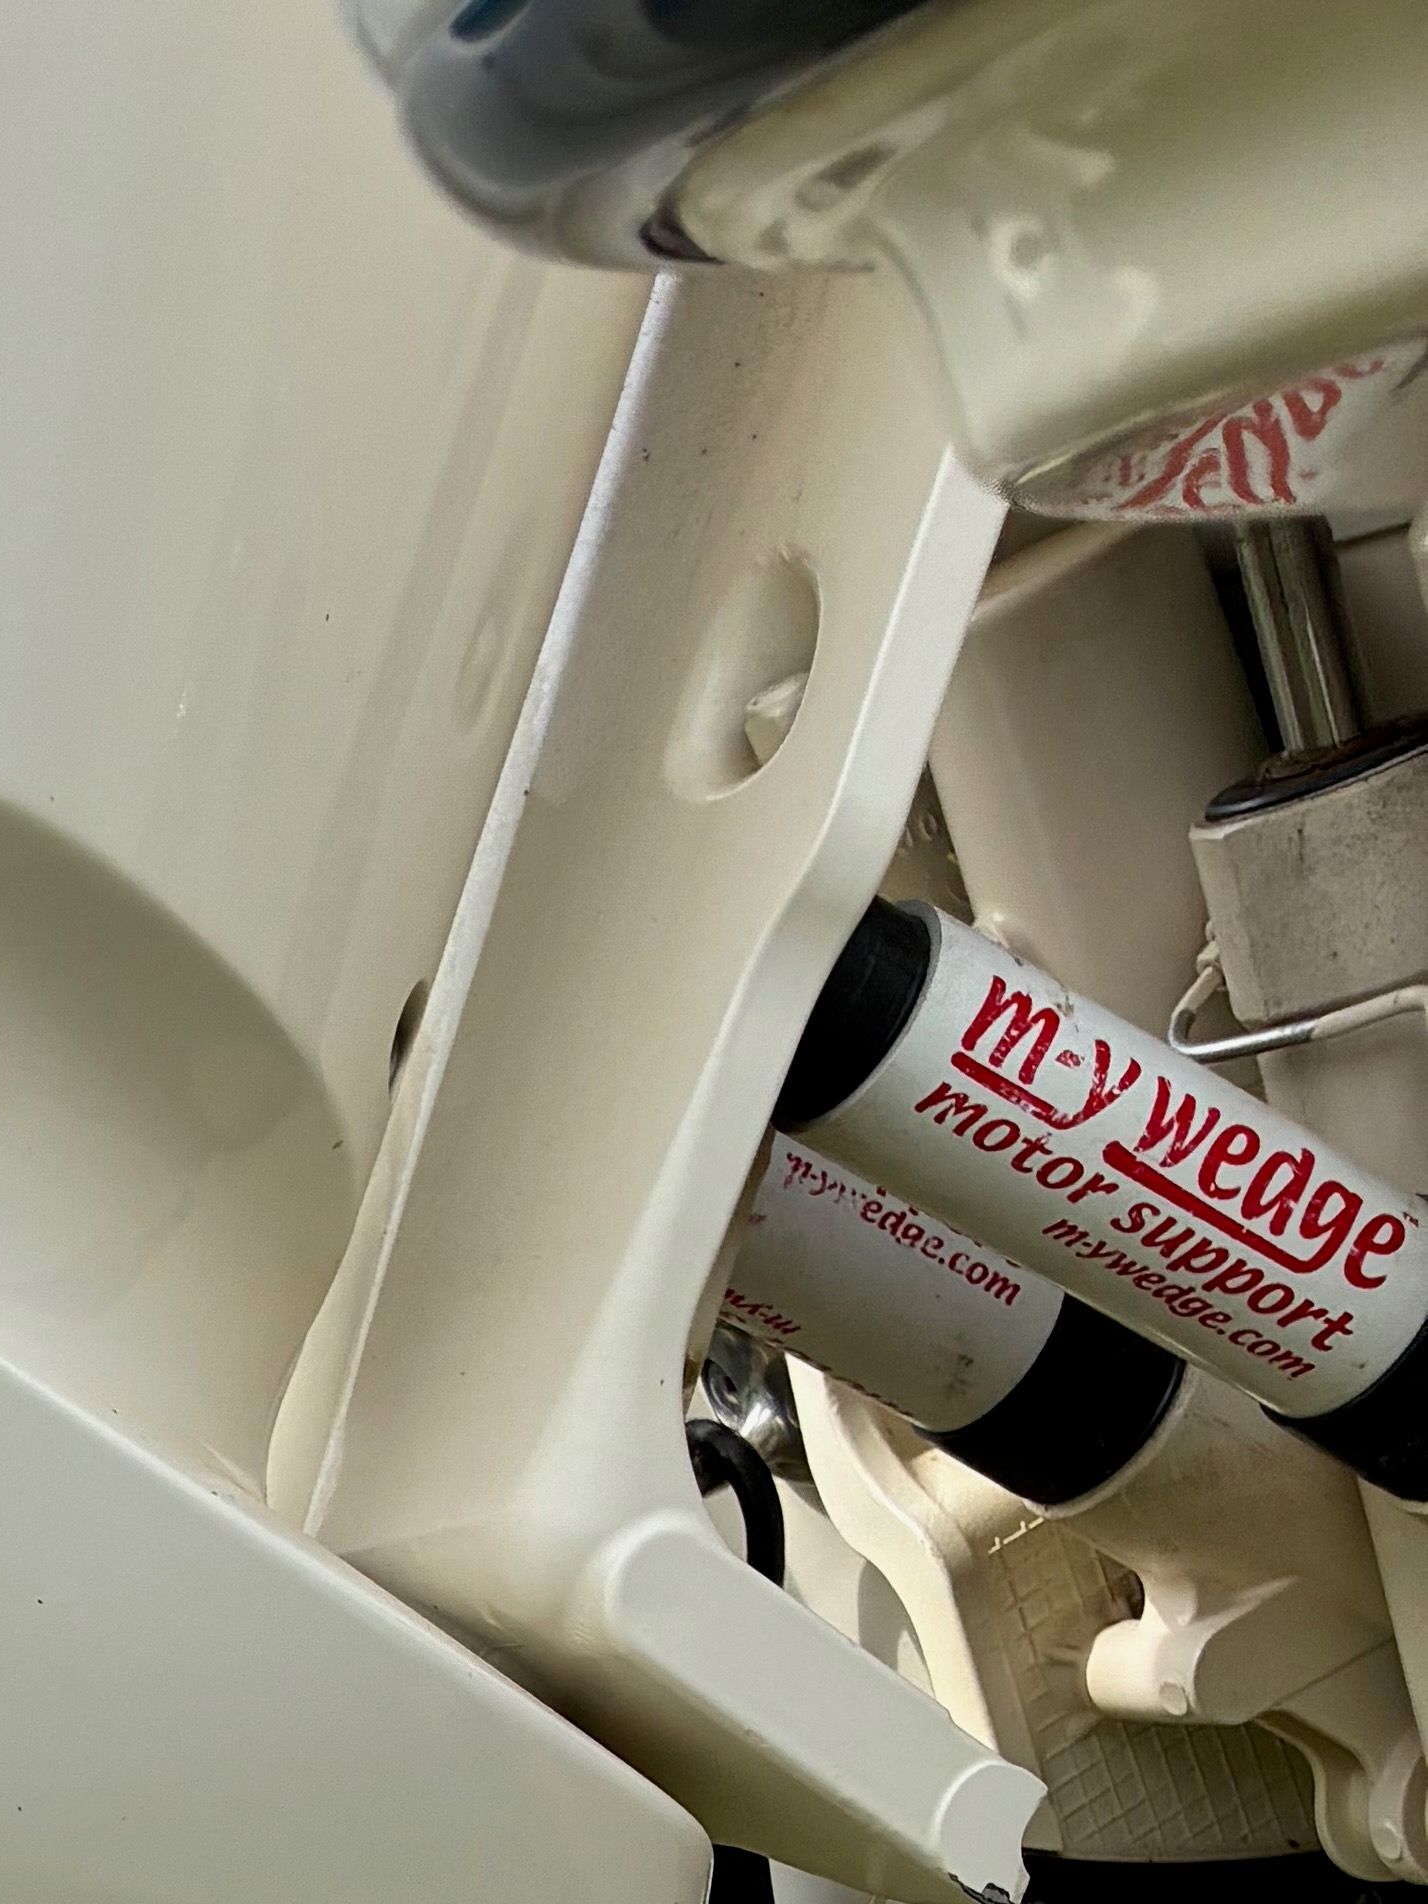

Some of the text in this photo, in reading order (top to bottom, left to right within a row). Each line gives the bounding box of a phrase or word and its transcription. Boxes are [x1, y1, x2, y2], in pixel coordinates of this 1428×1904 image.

[914, 1081, 1356, 1355] motor support
[950, 976, 1407, 1291] m-y wedge
[1042, 1217, 1316, 1382] m-ywedge.com
